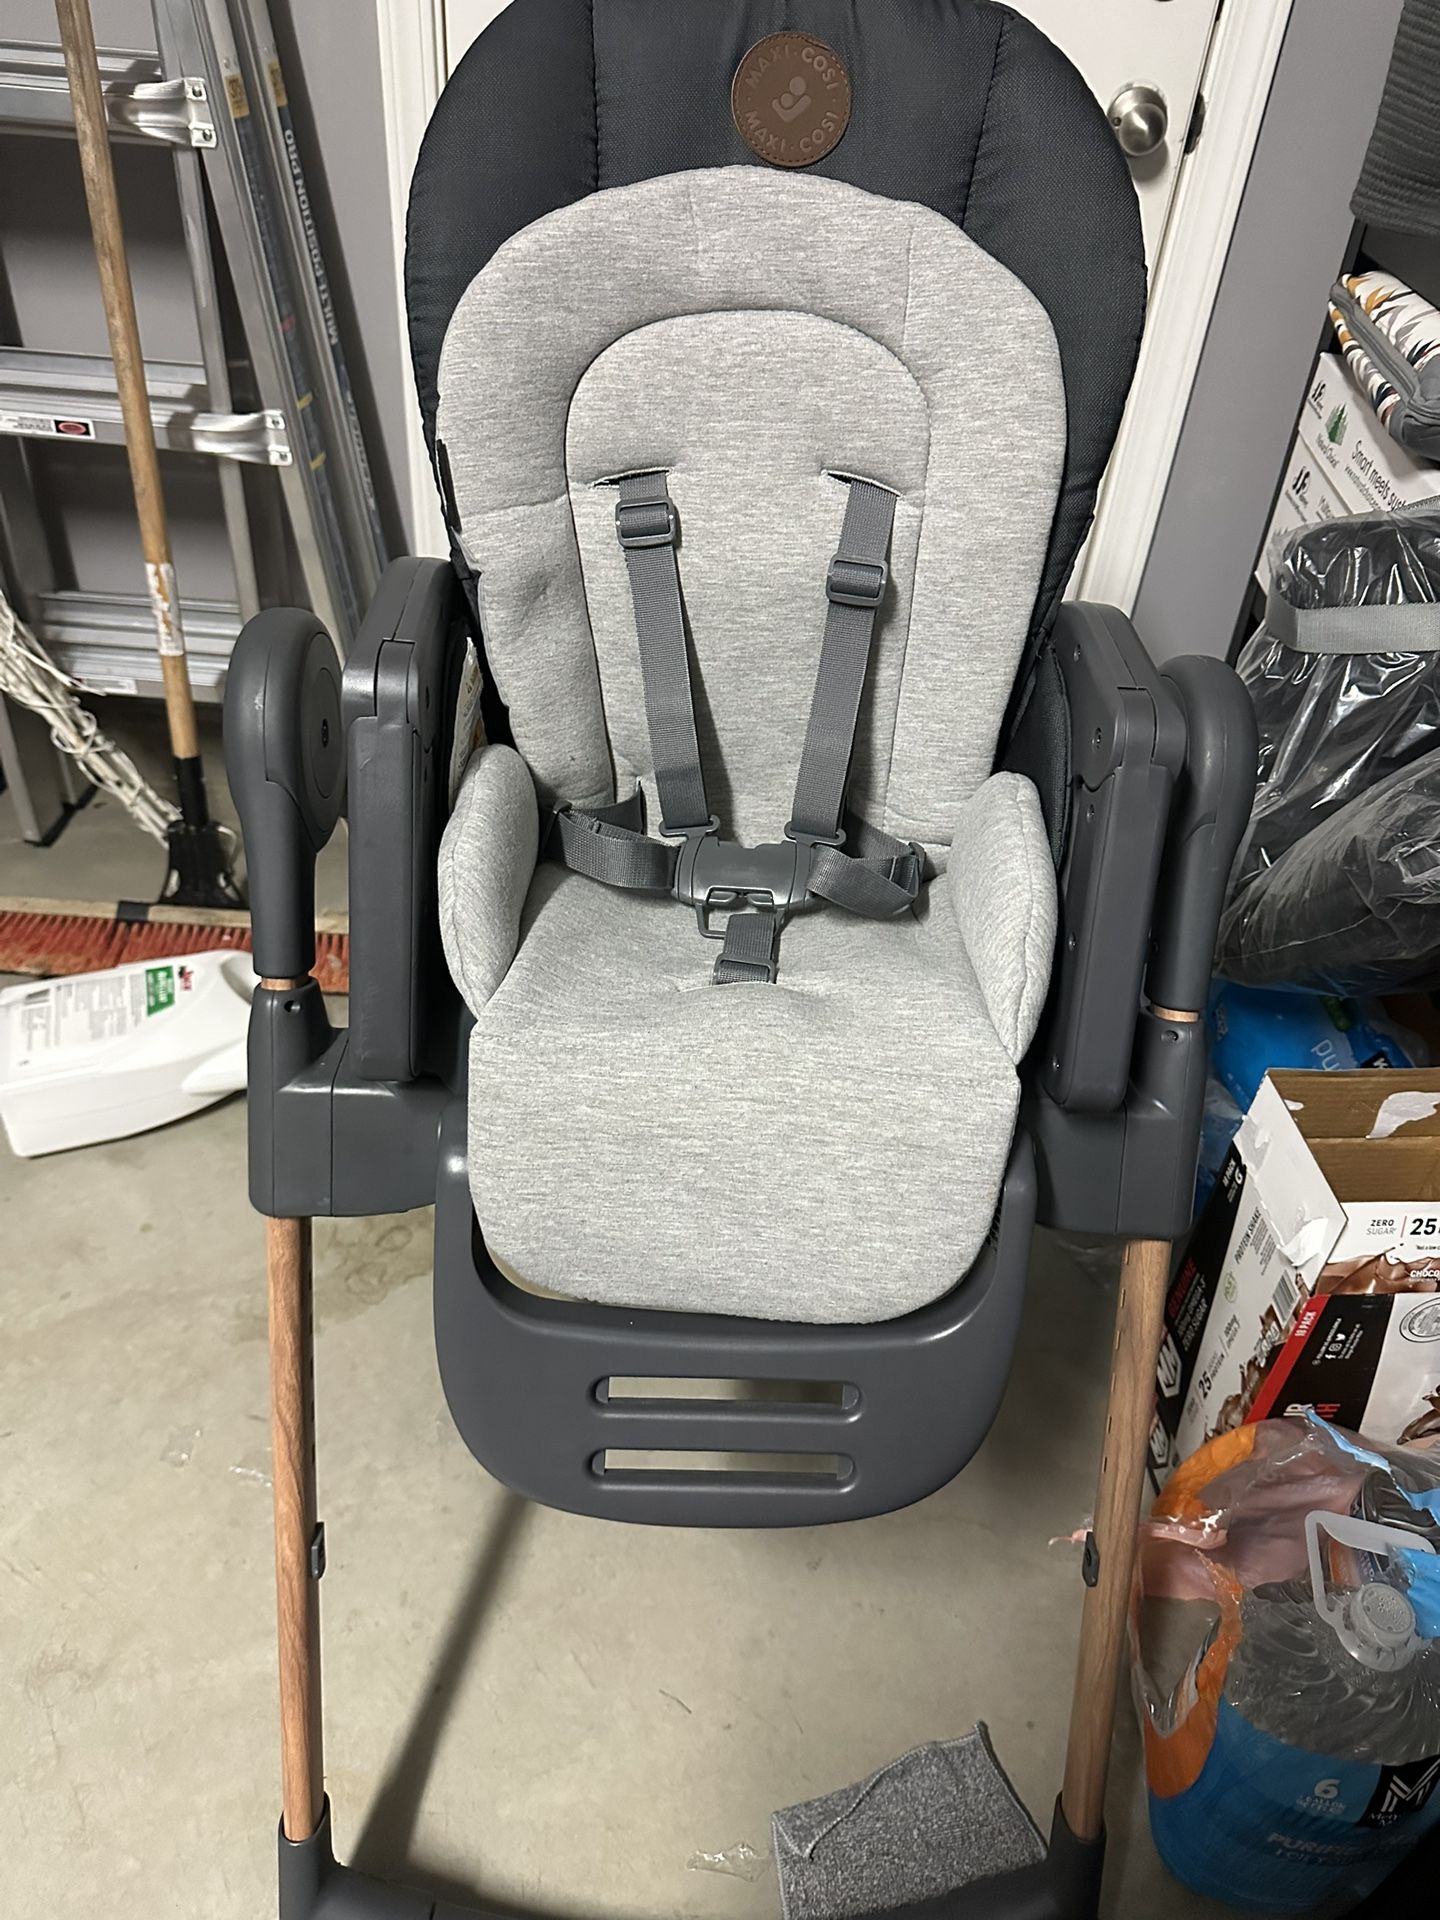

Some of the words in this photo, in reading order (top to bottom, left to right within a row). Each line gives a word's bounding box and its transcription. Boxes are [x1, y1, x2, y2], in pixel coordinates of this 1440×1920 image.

[801, 47, 839, 89] COSI
[800, 111, 839, 152] COSI
[285, 129, 301, 175] PRO
[1352, 440, 1374, 476] Smart
[1369, 469, 1390, 500] meets
[1370, 1219, 1395, 1227] ZERO
[1409, 1218, 1438, 1236] 25
[1234, 1230, 1252, 1265] PROTEIN
[1199, 1370, 1213, 1399] 25
[1313, 1778, 1342, 1799] 6
